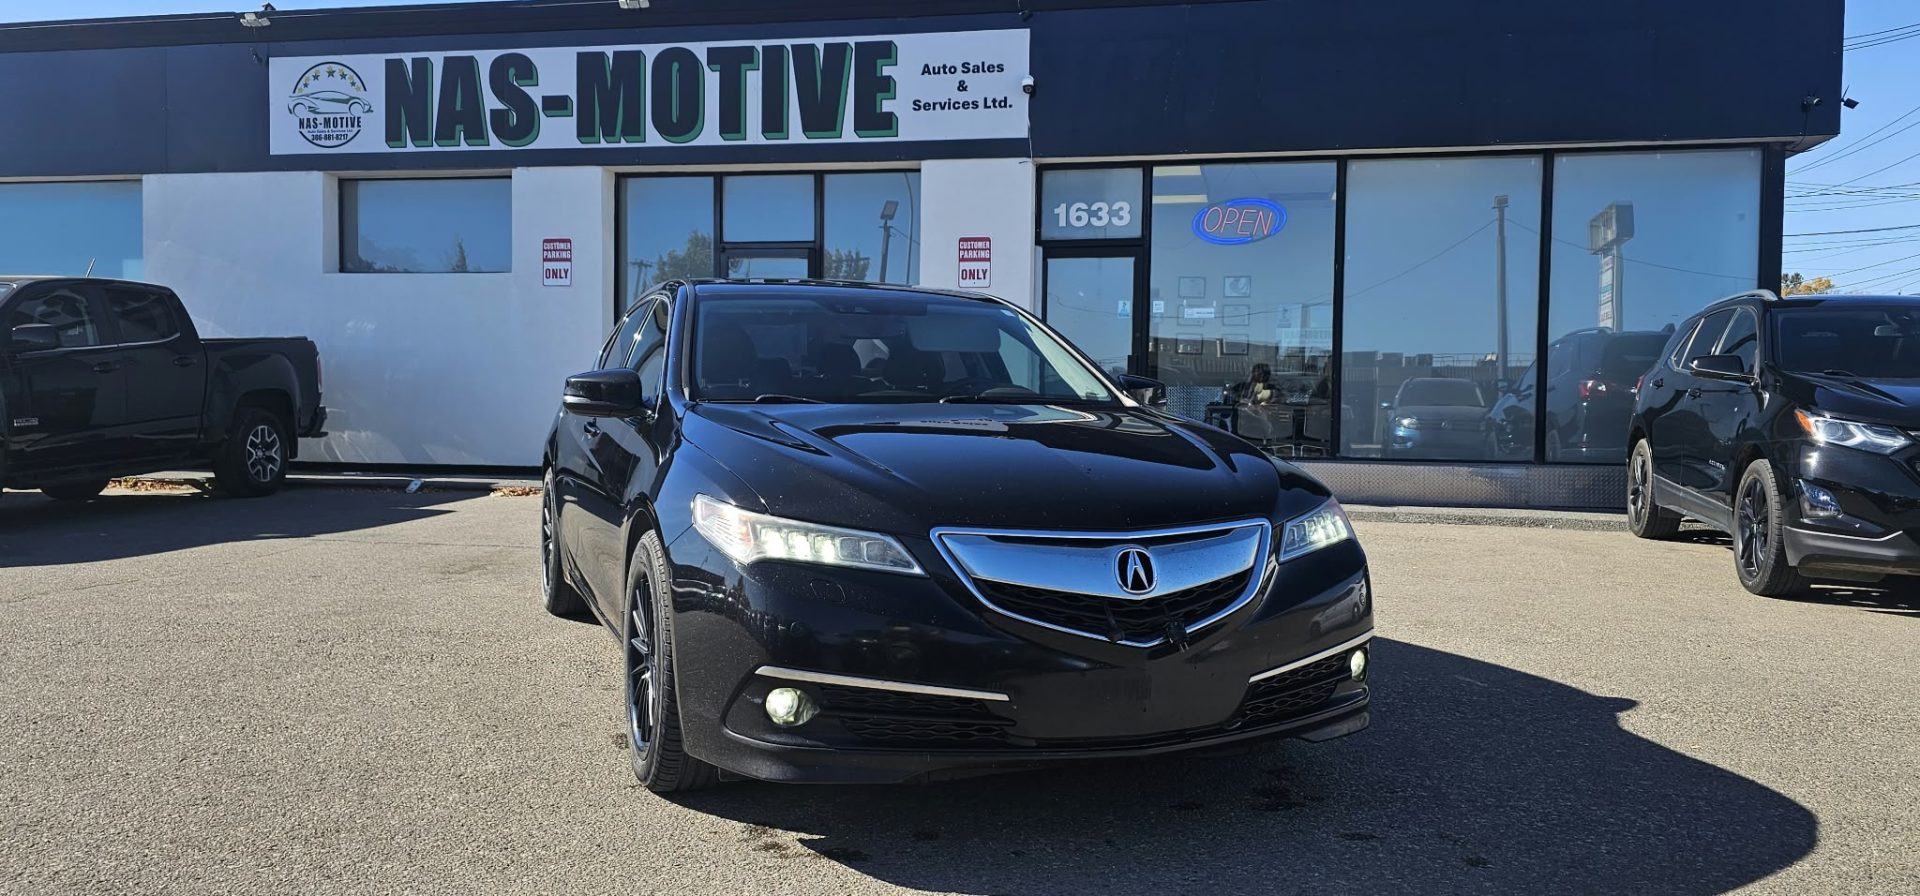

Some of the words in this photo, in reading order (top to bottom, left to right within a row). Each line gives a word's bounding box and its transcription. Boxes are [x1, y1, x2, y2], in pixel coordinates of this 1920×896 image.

[921, 63, 957, 76] Auto
[961, 61, 1005, 74] Sales
[957, 80, 968, 92] &
[384, 40, 898, 149] NAS-MOTIVE
[912, 98, 979, 111] Services
[983, 96, 1013, 109] Ltd.
[299, 116, 361, 129] NAS-MOTIVE
[1054, 201, 1131, 228] 1633
[1203, 206, 1273, 236] OPEN
[544, 242, 570, 250] CUSTOMER
[959, 241, 990, 249] CUSTOMER
[544, 250, 570, 259] PARKING
[960, 250, 990, 259] PARKING
[545, 268, 569, 279] ONLY
[961, 268, 988, 281] ONLY
